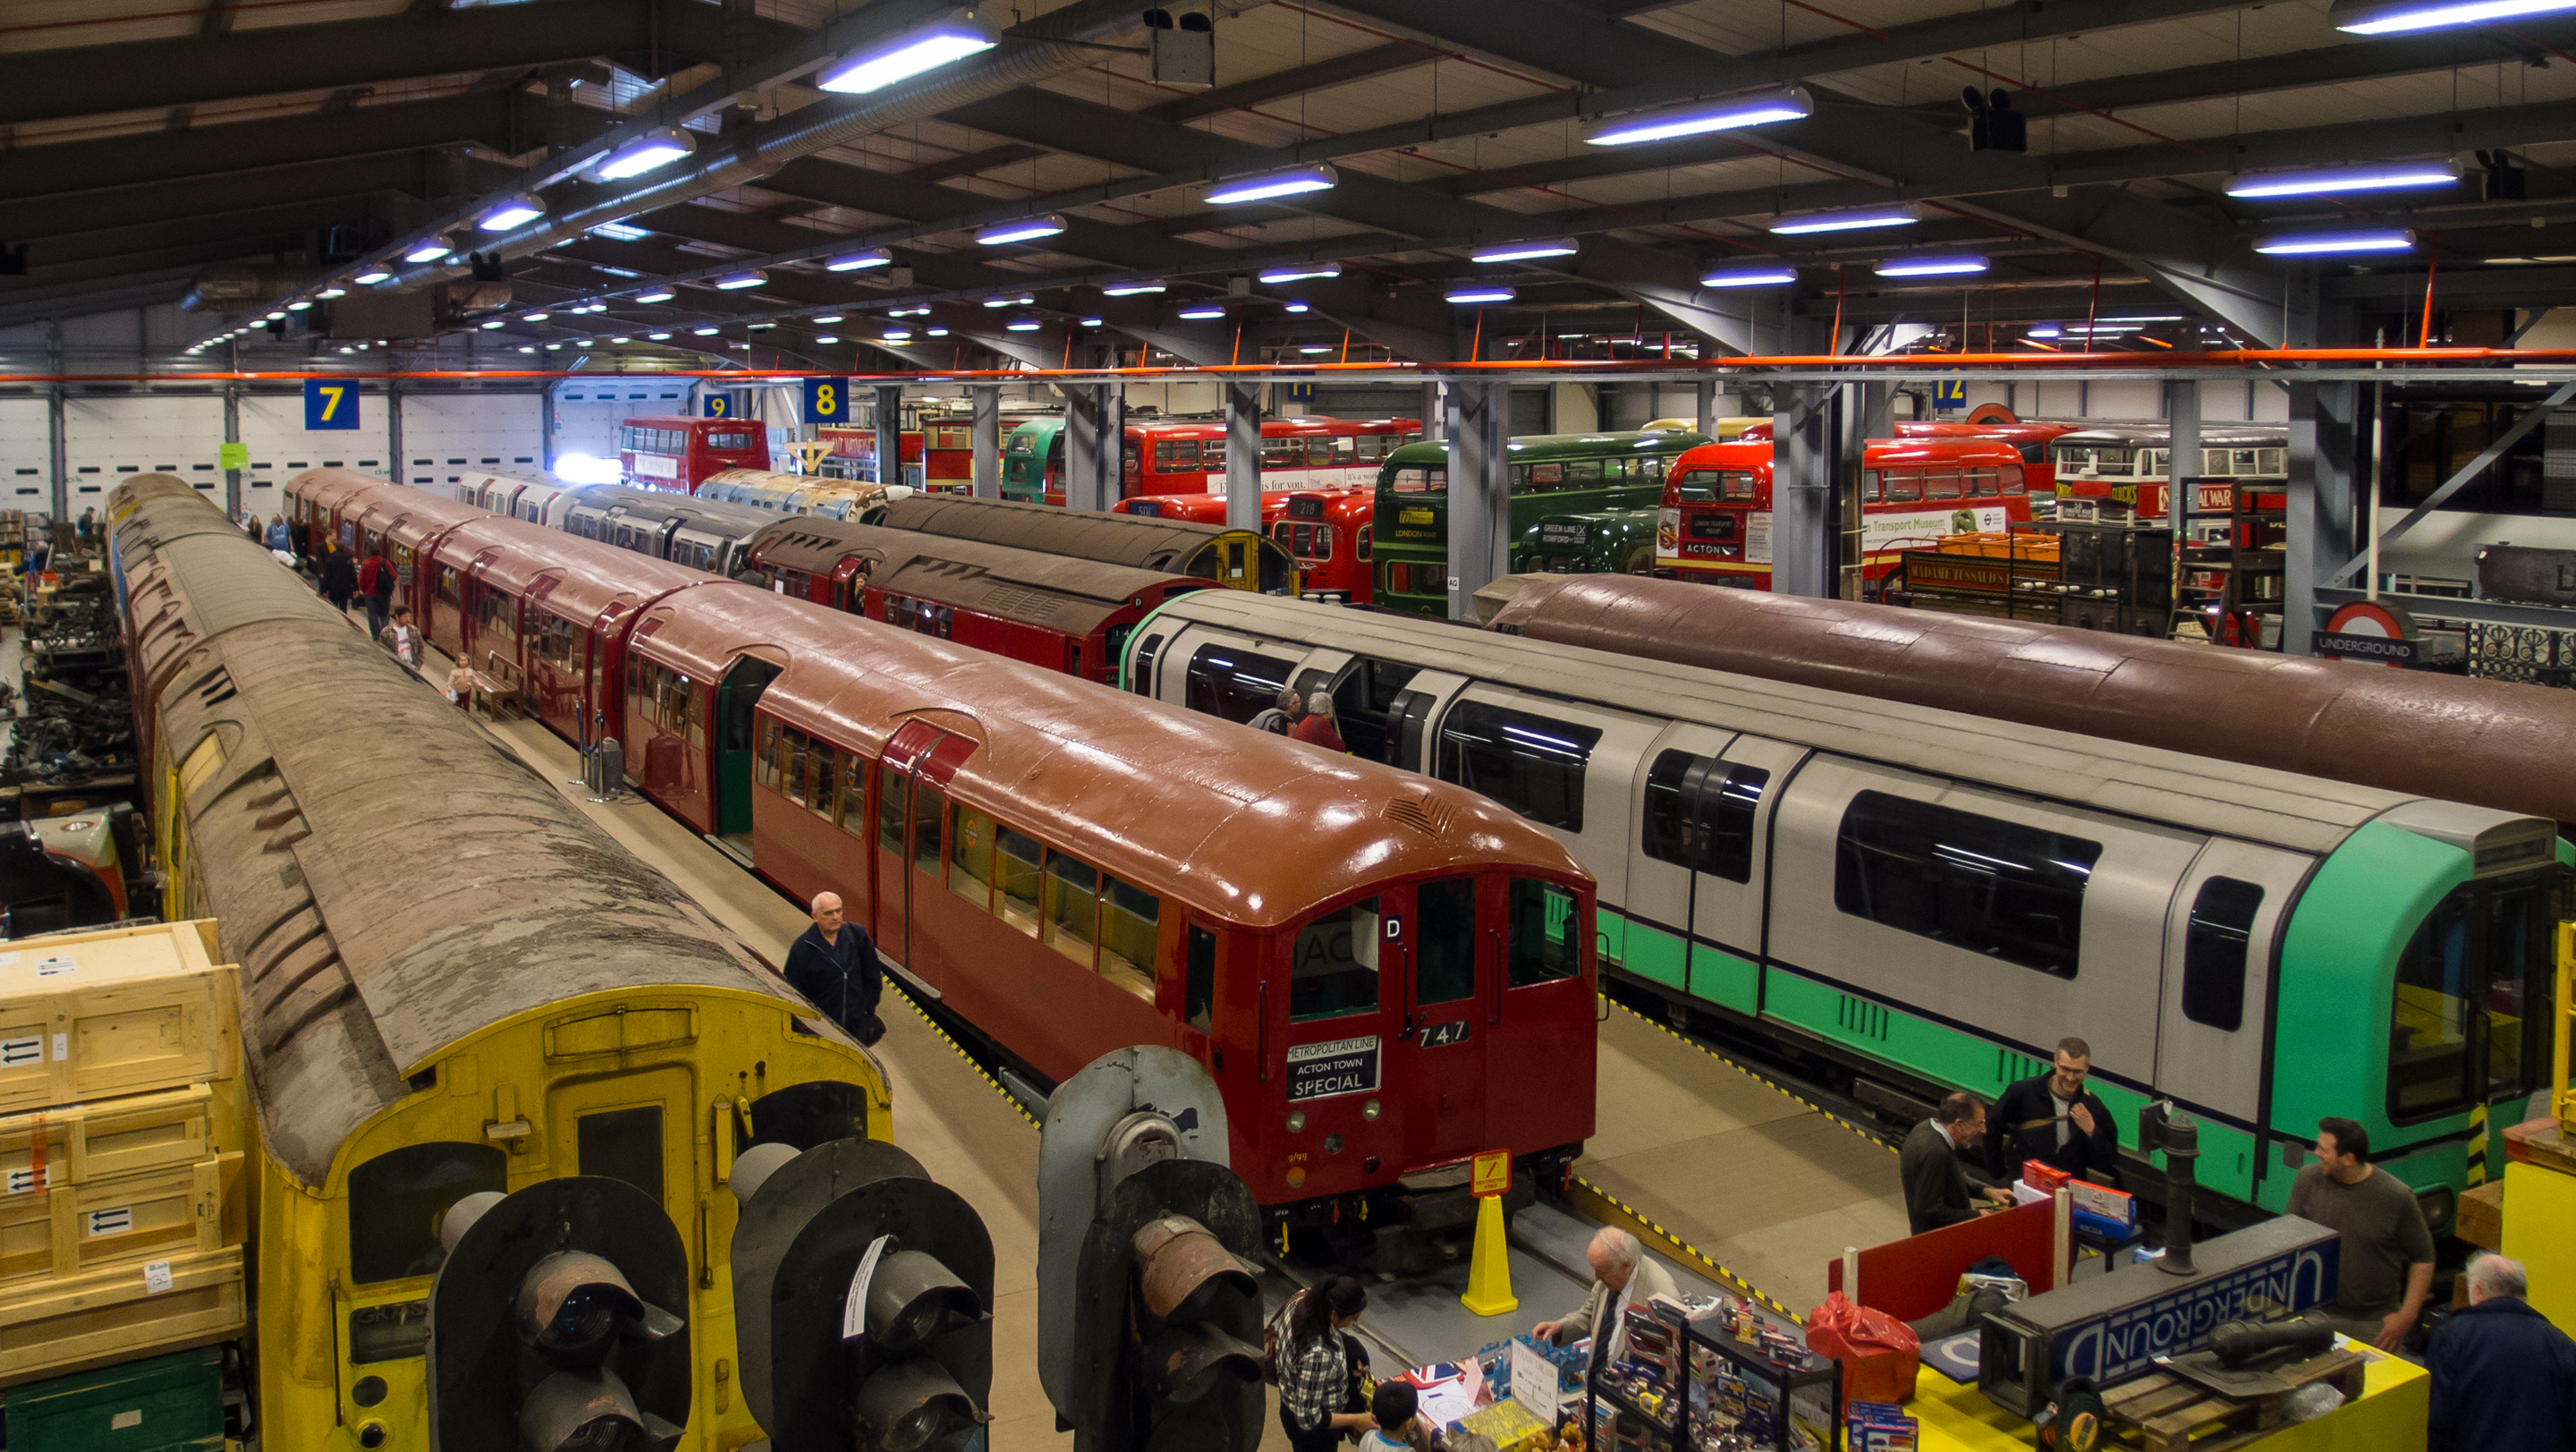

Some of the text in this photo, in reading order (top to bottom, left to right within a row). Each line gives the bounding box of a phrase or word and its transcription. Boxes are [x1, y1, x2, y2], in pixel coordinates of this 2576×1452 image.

[1938, 379, 1963, 399] 12
[319, 386, 344, 421] 7
[711, 398, 725, 417] 9
[816, 384, 836, 415] 8
[1261, 480, 1306, 491] is for you.
[2112, 484, 2138, 505] CLOCKS
[2209, 489, 2232, 506] WAR
[1301, 503, 1315, 515] 218
[1544, 524, 1563, 532] GREEN
[1563, 525, 1576, 533] LINE
[1874, 520, 1911, 533] Transport
[1913, 517, 1945, 529] Museum
[1686, 544, 1720, 554] ACTON
[1912, 565, 1951, 580] MADAME
[1135, 598, 1141, 607] D
[2319, 637, 2411, 657] UNDERGROUND
[1386, 920, 1401, 938] D
[1420, 1020, 1465, 1047] 747
[1288, 1037, 1376, 1058] METROPOLITAN LINE
[1297, 1057, 1363, 1075] ACTON TOWN
[1295, 1074, 1363, 1096] SPECIAL
[2064, 1250, 2323, 1382] UNDERGROUND
